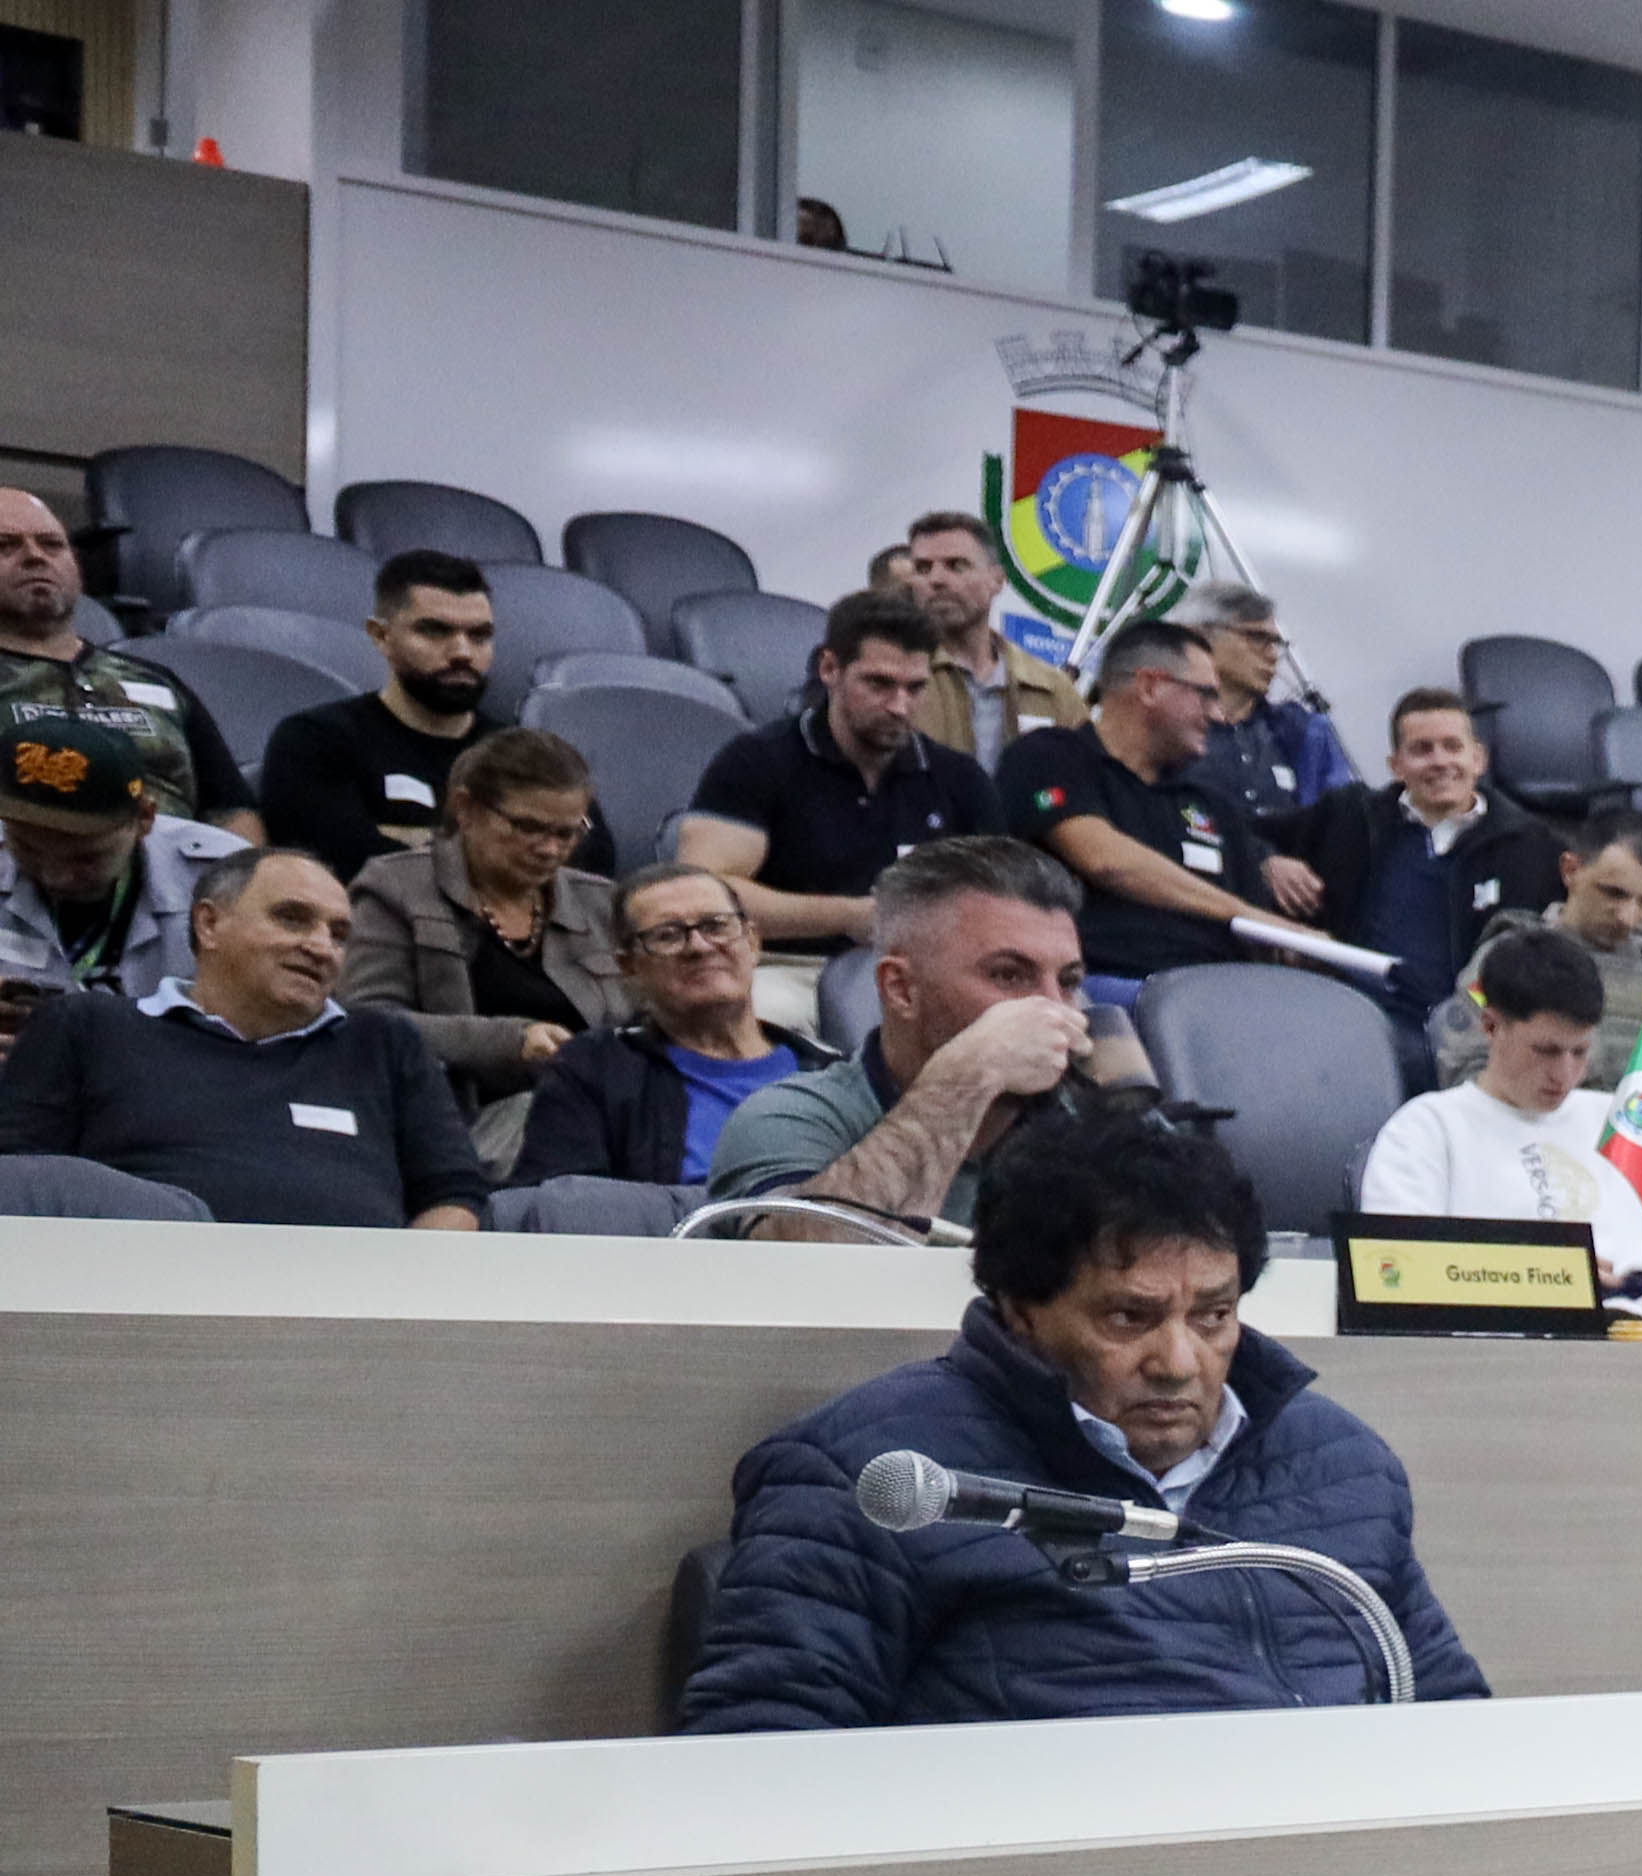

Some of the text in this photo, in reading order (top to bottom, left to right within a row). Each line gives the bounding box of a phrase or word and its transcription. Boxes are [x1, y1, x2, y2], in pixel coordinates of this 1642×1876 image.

[1520, 1142, 1556, 1220] VERSAC
[1446, 1264, 1573, 1286] Gustavo Finck
